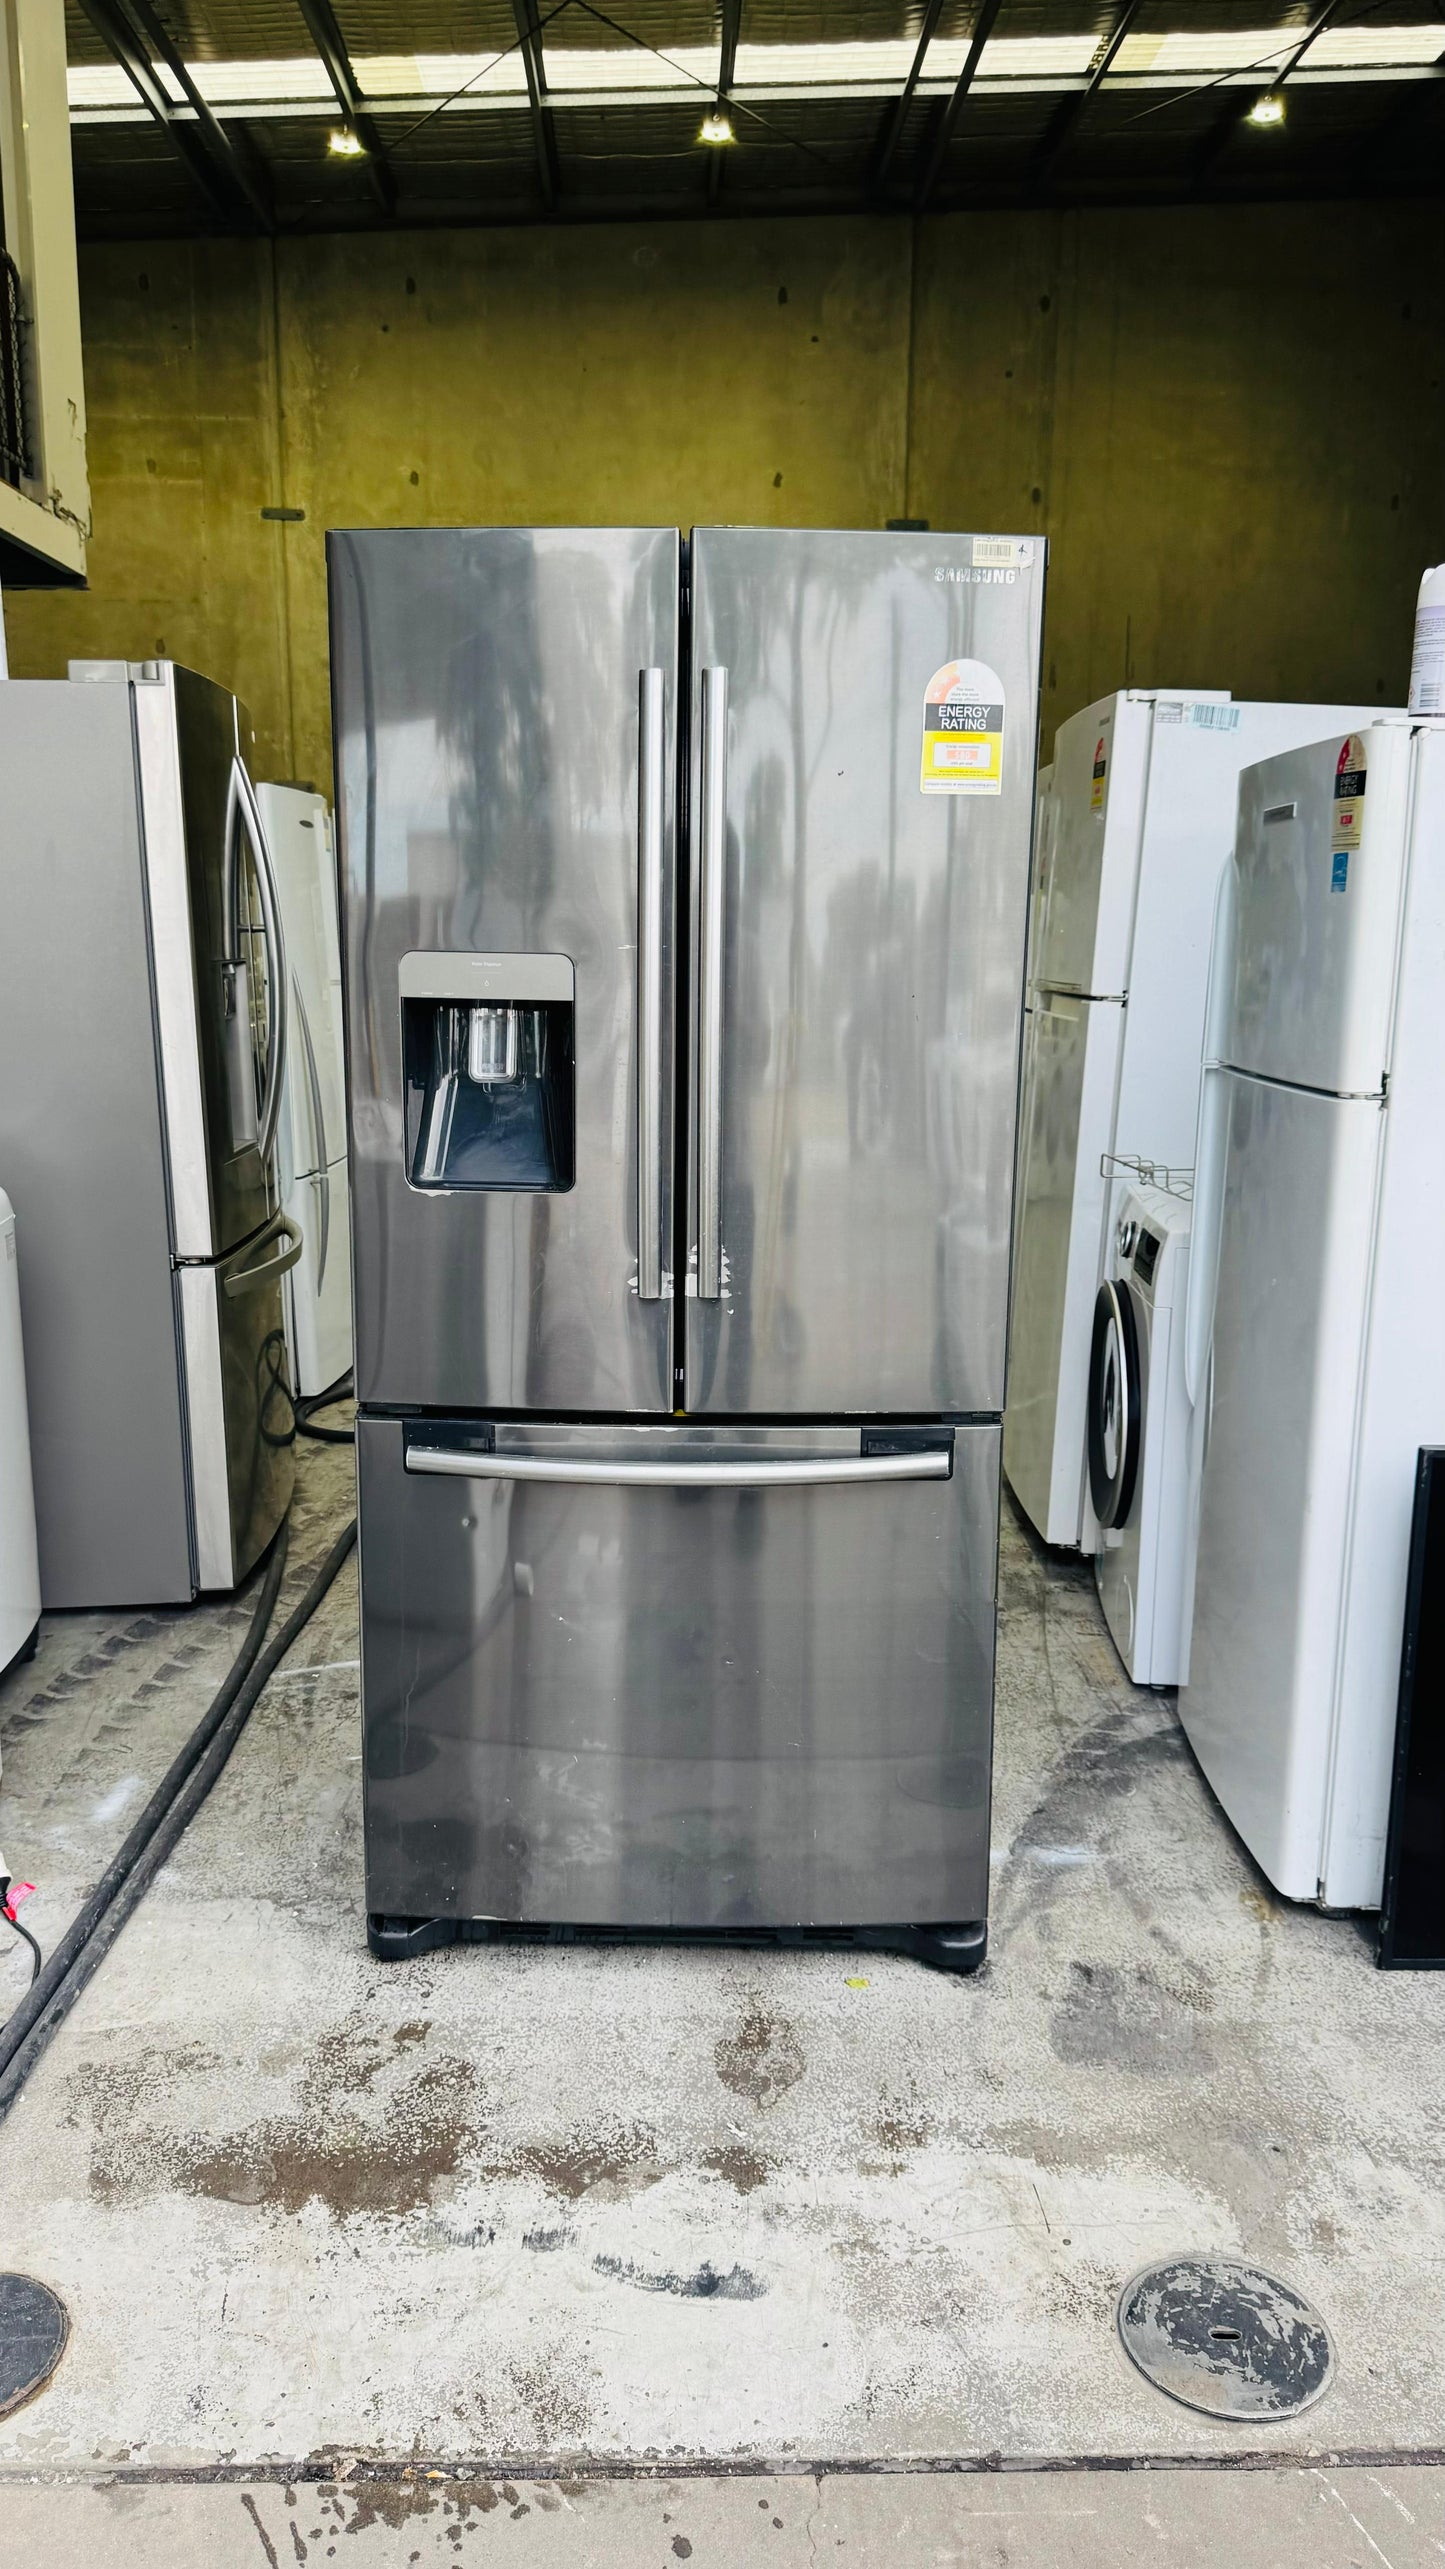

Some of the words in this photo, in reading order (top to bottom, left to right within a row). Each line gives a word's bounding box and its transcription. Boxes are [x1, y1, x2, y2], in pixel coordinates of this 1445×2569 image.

[935, 567, 1016, 584] SAMSUNG
[938, 705, 991, 718] ENERGY
[941, 718, 987, 730] RATING
